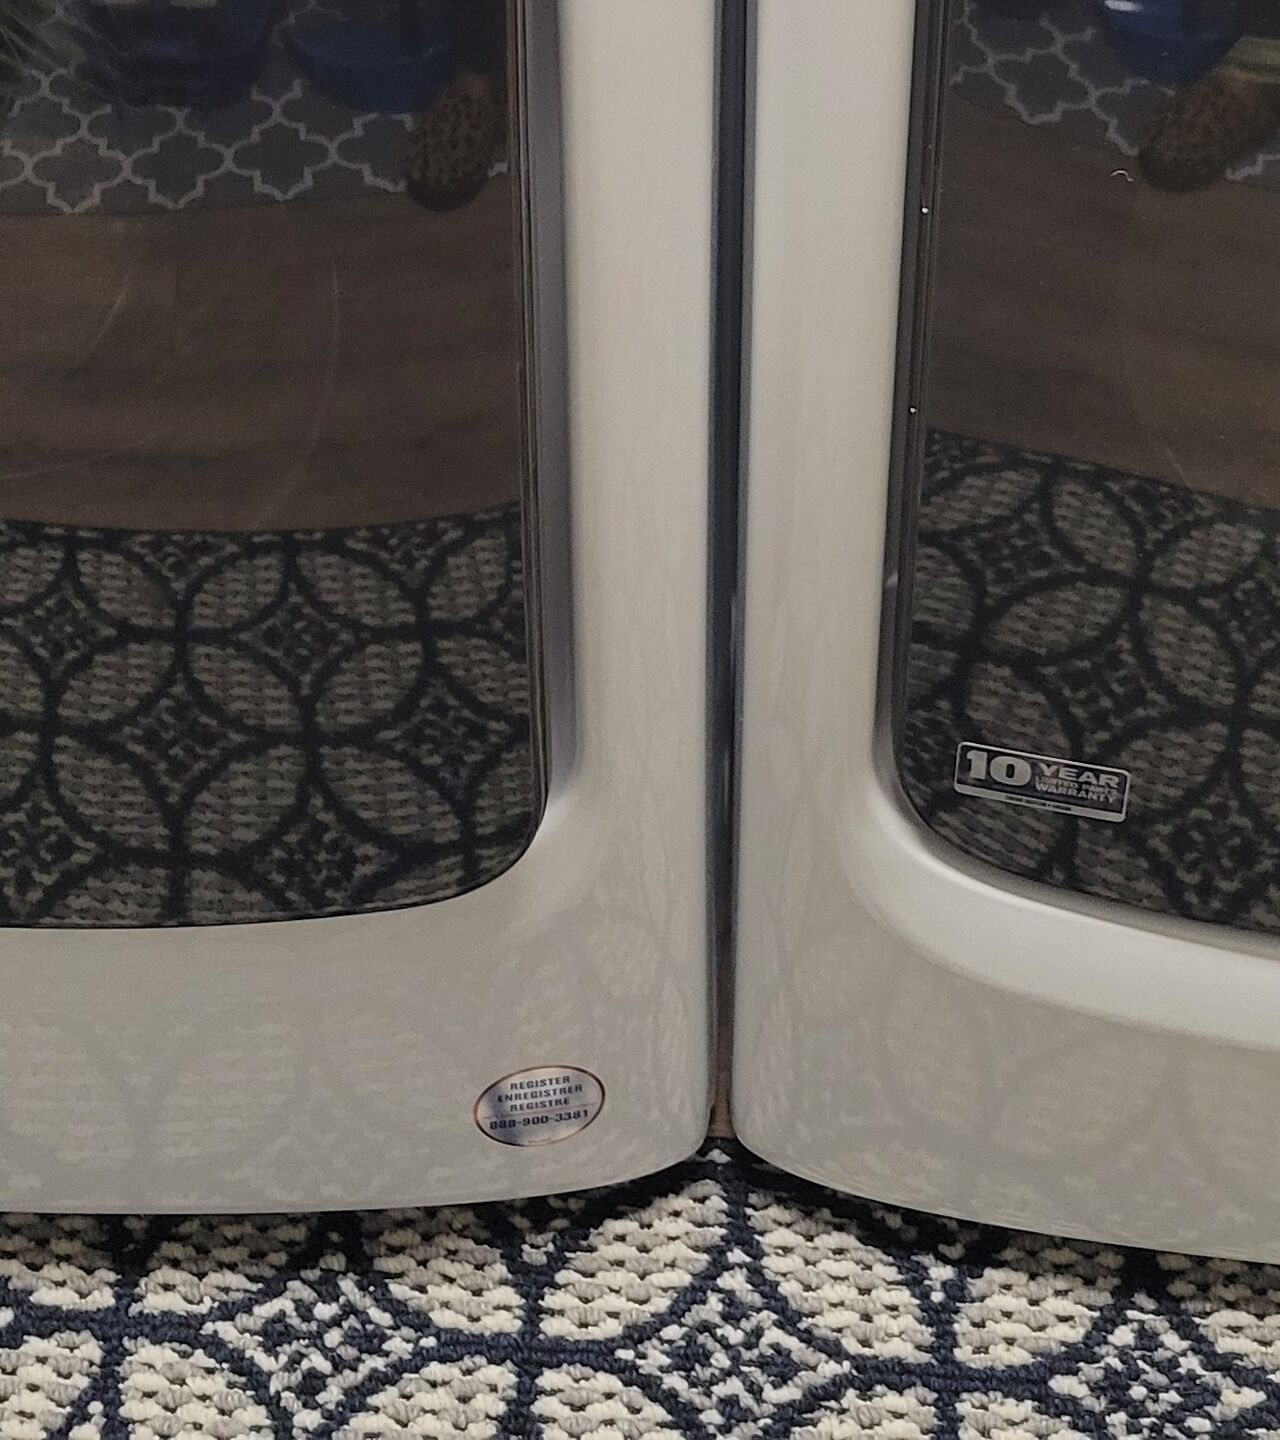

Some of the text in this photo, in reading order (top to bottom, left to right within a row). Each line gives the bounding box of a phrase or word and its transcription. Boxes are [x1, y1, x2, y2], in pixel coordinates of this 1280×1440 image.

[967, 749, 1119, 788] 10 YEAR
[1035, 782, 1118, 804] WARRANTY
[509, 1075, 571, 1091] REGISTER
[497, 1084, 583, 1103] ENREGISTRER
